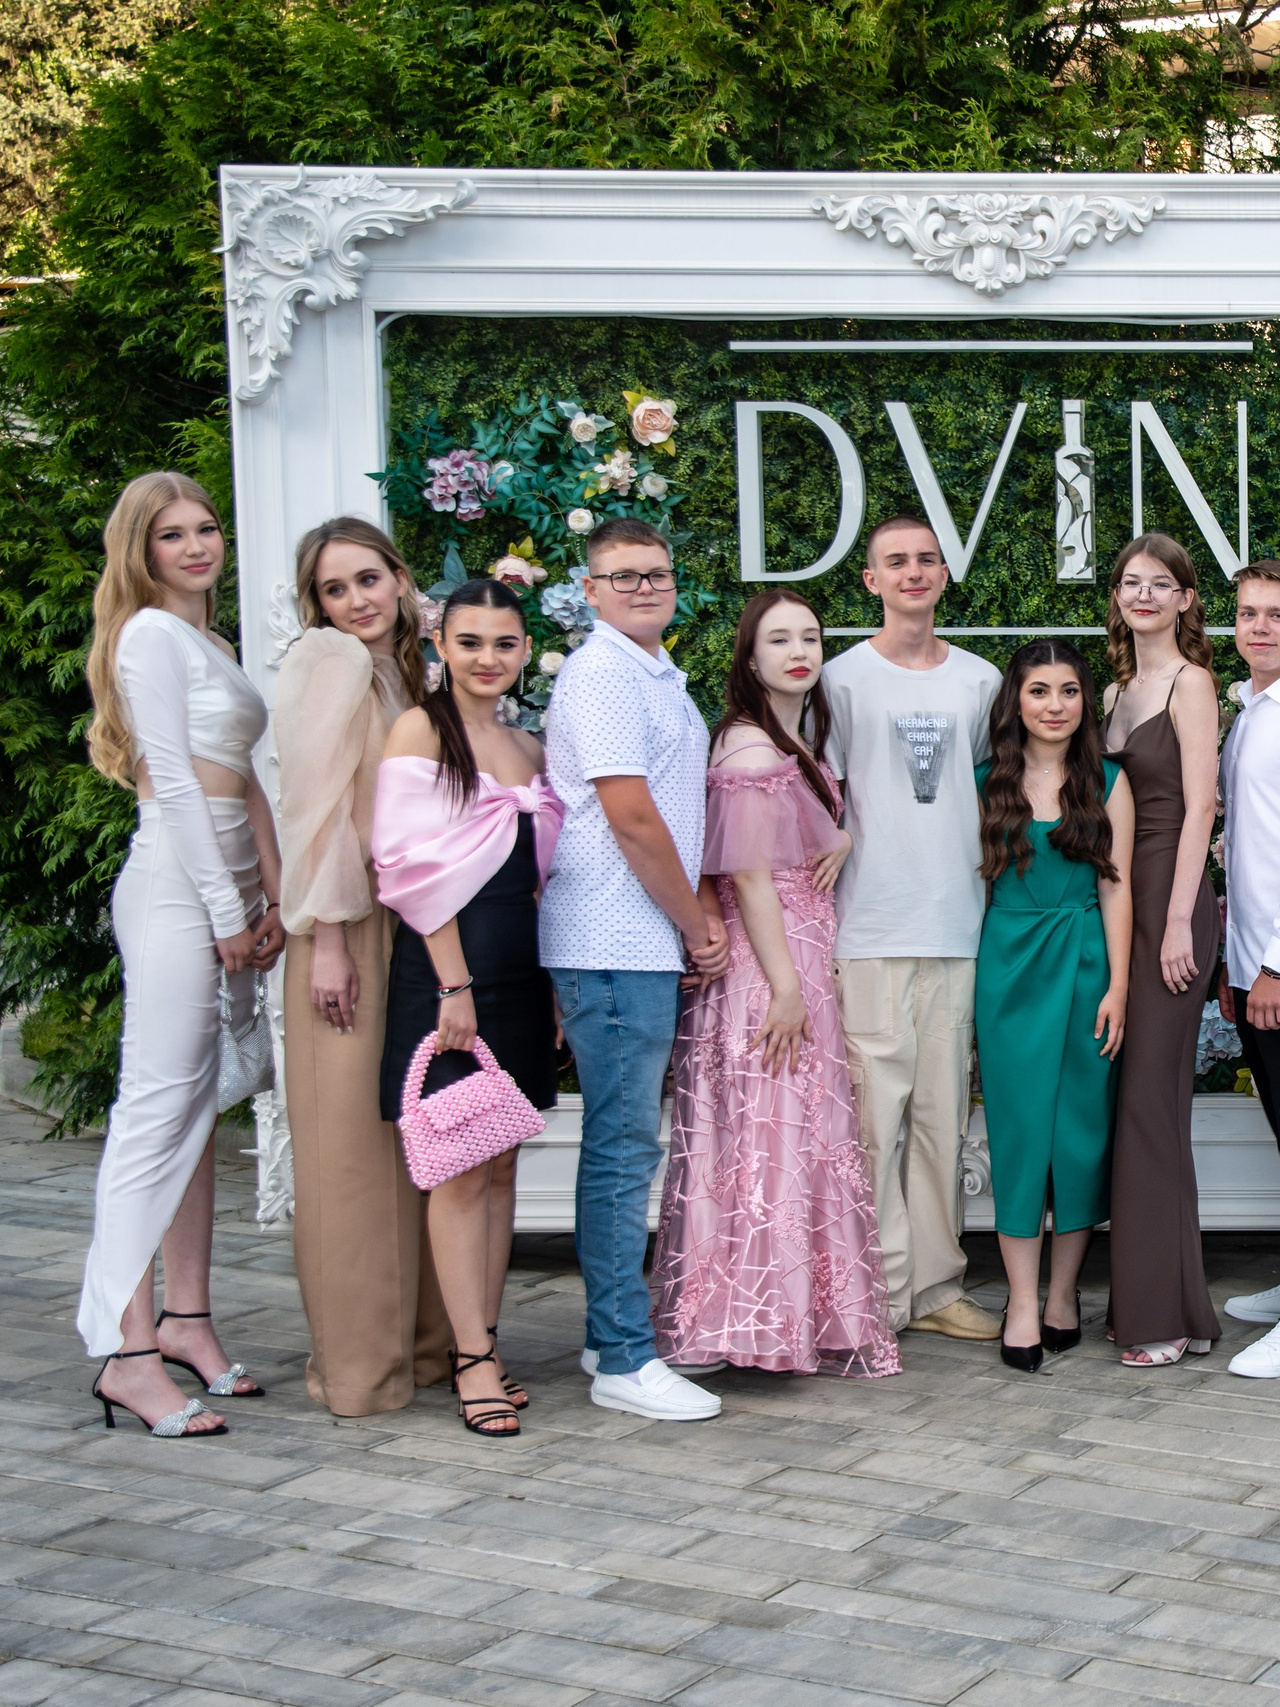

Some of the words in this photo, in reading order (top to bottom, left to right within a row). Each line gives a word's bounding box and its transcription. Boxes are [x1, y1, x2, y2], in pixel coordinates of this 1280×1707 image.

[735, 399, 1249, 583] DVIN
[897, 718, 948, 728] HERMENB
[907, 731, 941, 742] EHRKN
[914, 745, 934, 756] ERH
[919, 759, 929, 770] M
